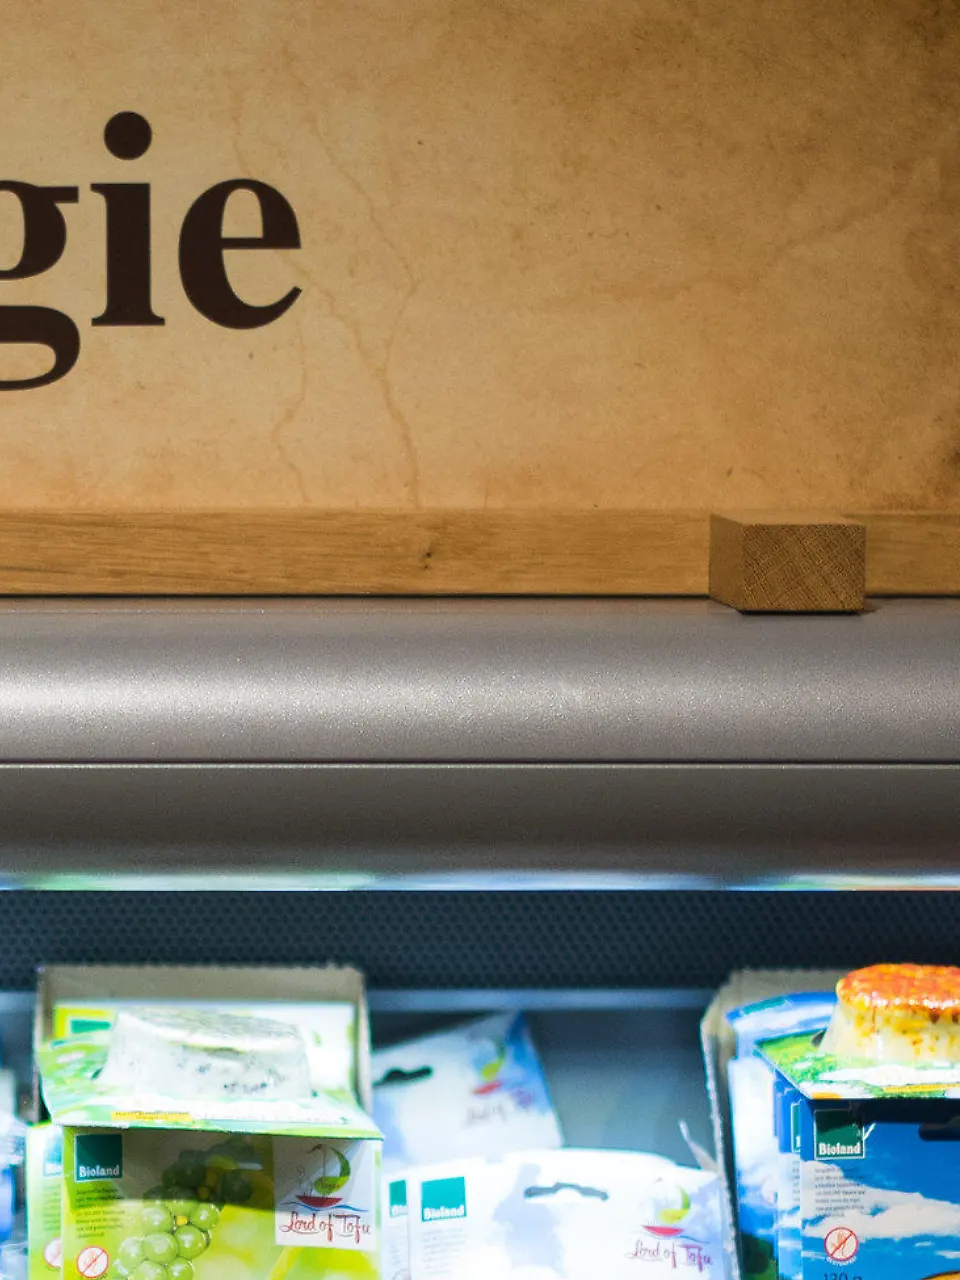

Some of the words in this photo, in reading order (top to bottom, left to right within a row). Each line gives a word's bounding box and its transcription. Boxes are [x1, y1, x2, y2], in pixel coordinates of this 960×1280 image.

[819, 1142, 861, 1155] Bioland
[79, 1164, 120, 1178] Bioland
[279, 1212, 317, 1236] Lord
[318, 1214, 334, 1242] of
[335, 1213, 372, 1244] Tofu
